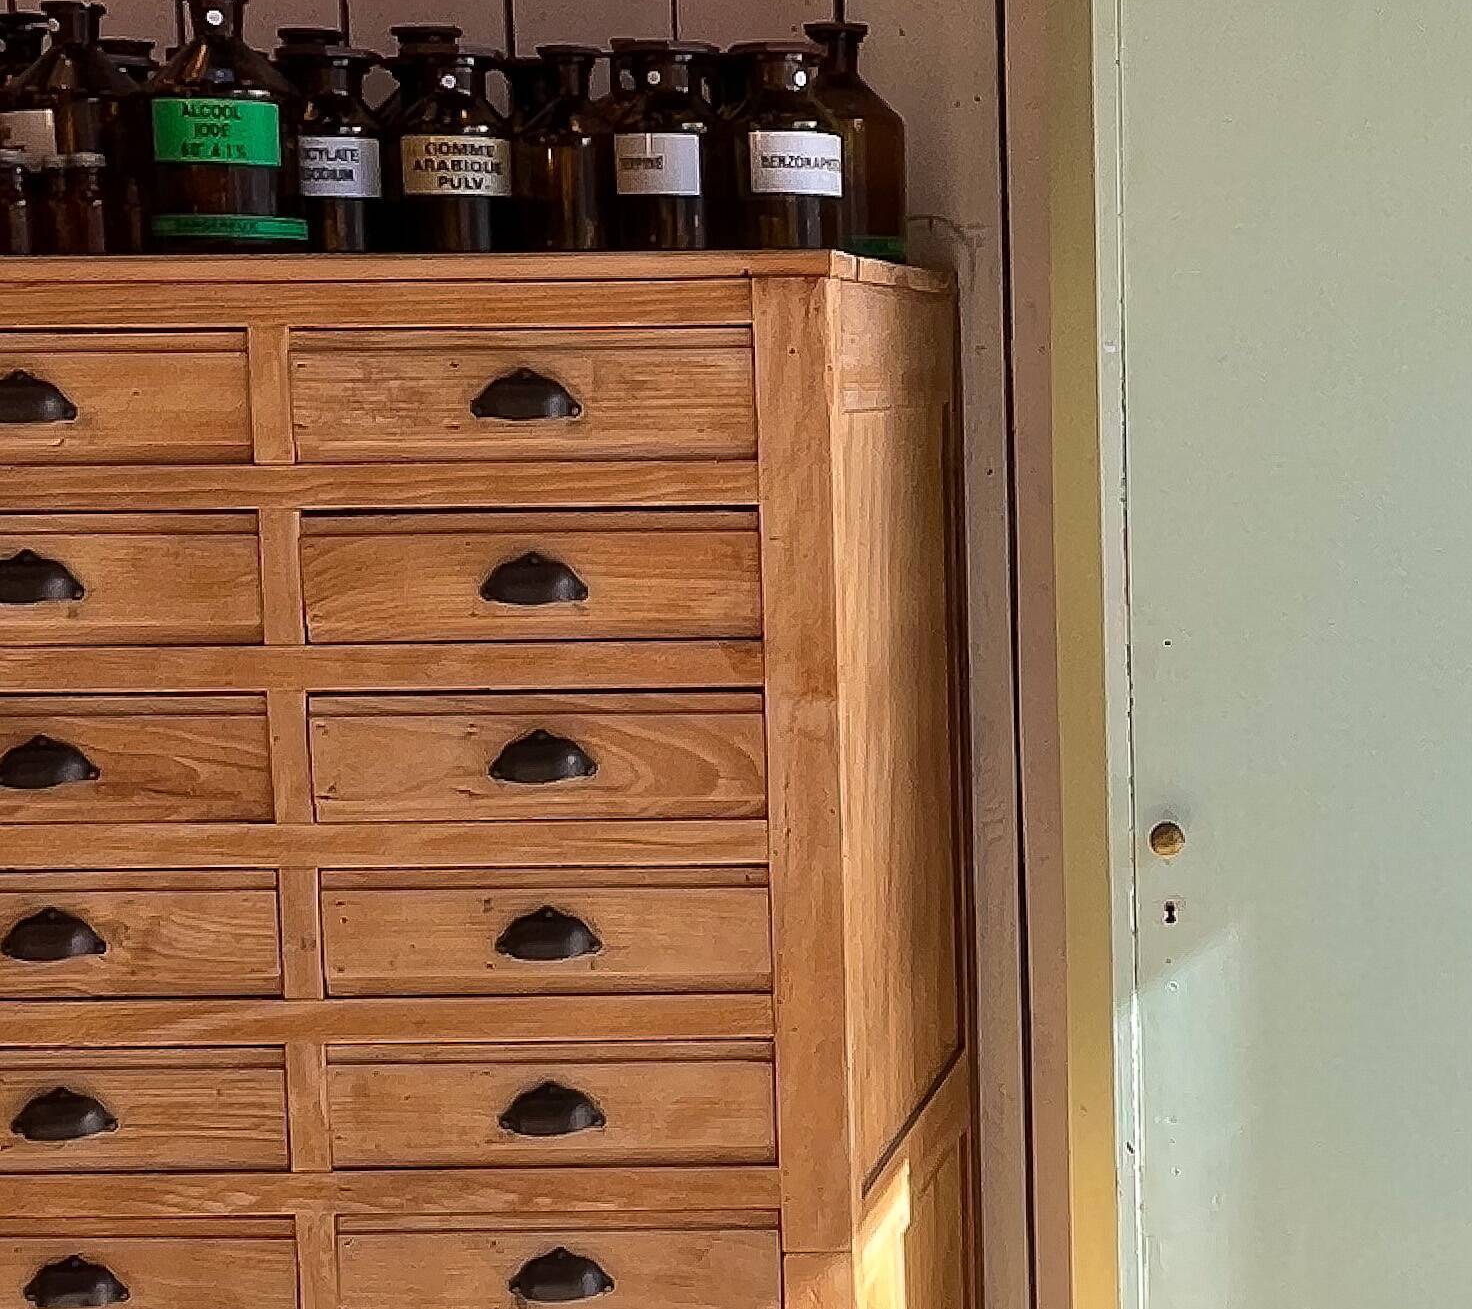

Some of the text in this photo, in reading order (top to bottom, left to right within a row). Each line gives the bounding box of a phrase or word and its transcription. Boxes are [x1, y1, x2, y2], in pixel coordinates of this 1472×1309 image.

[181, 102, 241, 121] ALCOOL
[424, 141, 495, 159] GOMME
[411, 158, 502, 176] ARABIQUE
